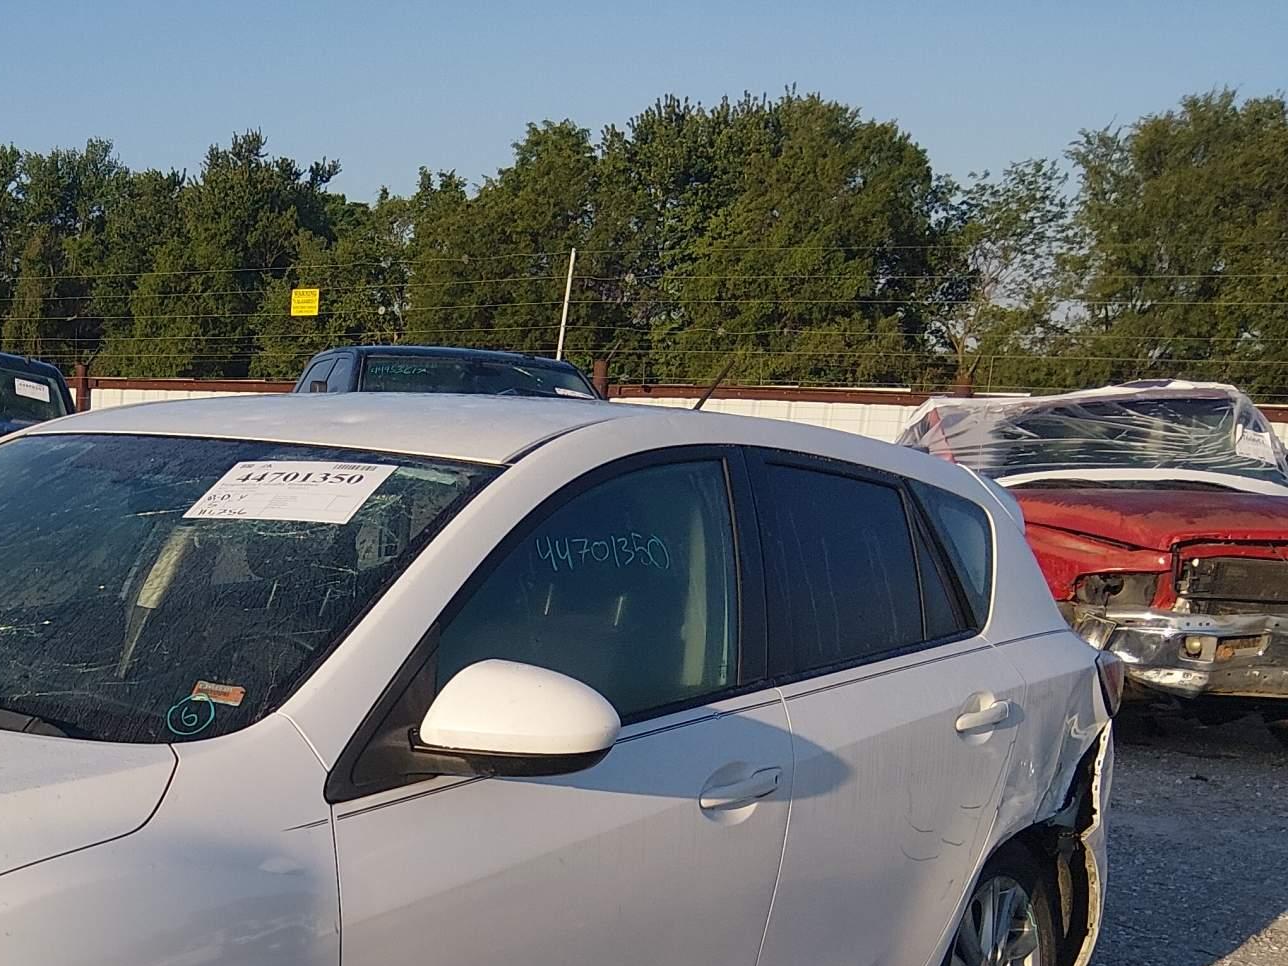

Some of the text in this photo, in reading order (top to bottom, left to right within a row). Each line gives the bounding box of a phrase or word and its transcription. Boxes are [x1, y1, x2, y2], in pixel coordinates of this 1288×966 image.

[236, 471, 365, 485] 44701350
[536, 532, 670, 571] 44701350
[182, 704, 198, 727] 6
